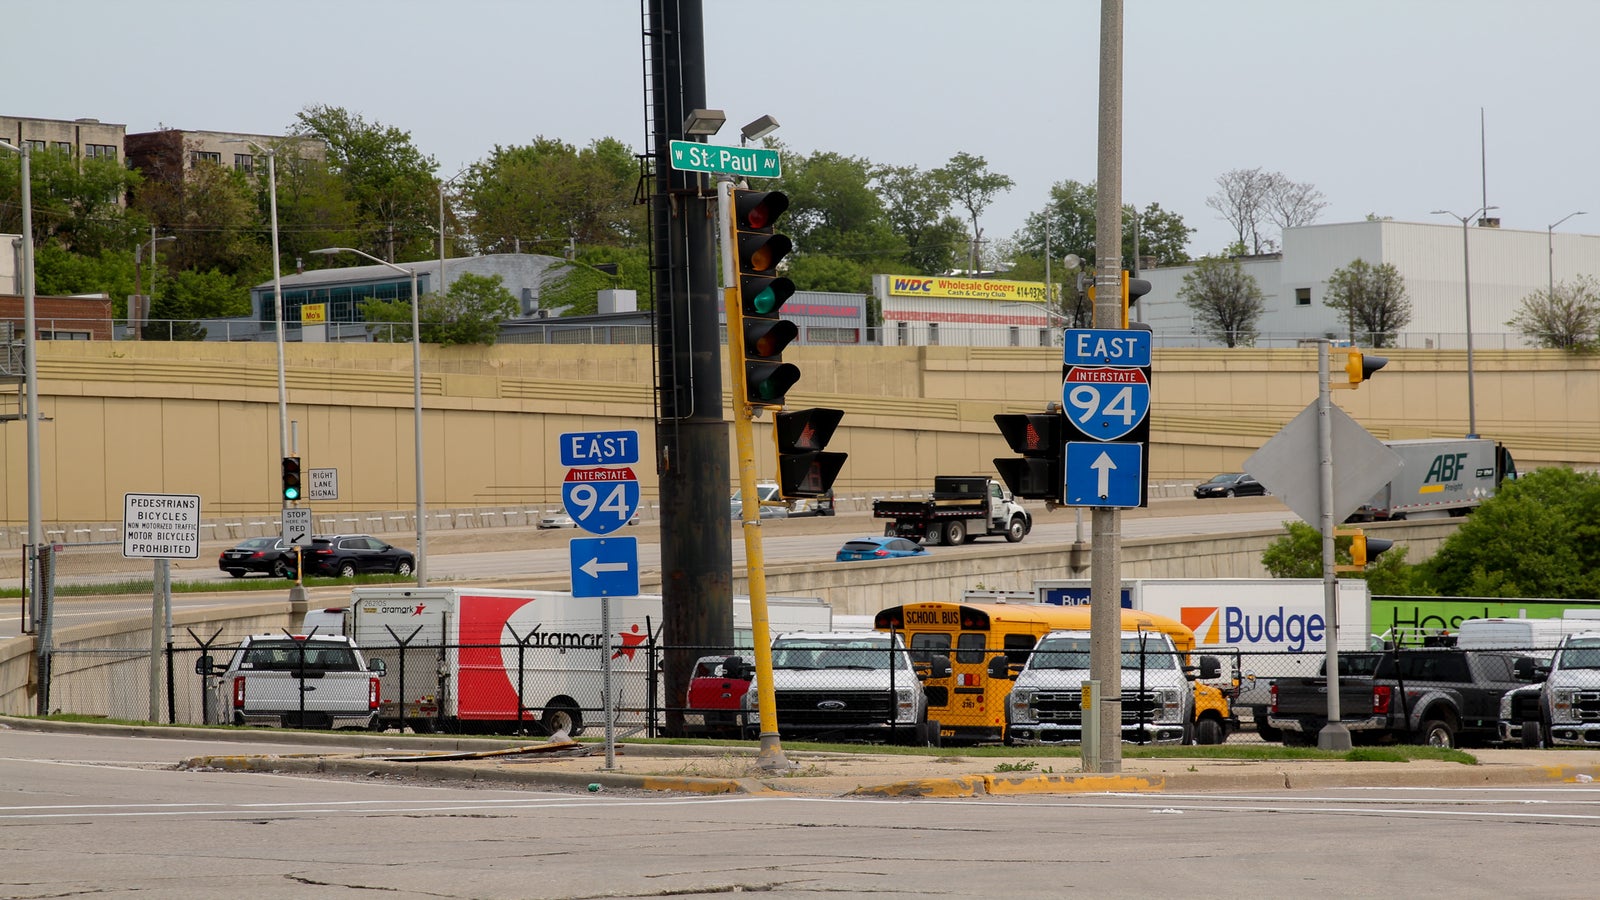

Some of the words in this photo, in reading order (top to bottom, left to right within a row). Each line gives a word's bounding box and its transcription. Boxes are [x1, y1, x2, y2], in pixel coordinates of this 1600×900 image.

[675, 150, 683, 160] W
[690, 147, 715, 168] St.
[720, 150, 757, 172] Paul
[764, 158, 776, 169] AV
[895, 278, 933, 292] WDC
[938, 280, 981, 291] Wholesale
[984, 282, 1015, 292] Grocers
[1077, 333, 1138, 358] EAST
[1076, 371, 1136, 382] INTERSTATE
[1069, 385, 1136, 425] 94
[572, 436, 628, 458] EAST
[1424, 453, 1468, 483] ABF
[573, 470, 628, 480] INTERSTATE
[131, 499, 195, 509] PEDESTRIANS
[570, 483, 630, 521] 94
[138, 511, 188, 521] BICYCLES
[128, 531, 153, 540] MOTOR
[157, 532, 195, 541] BICYCLES
[132, 544, 191, 554] PROHIBITED
[1062, 595, 1092, 606] Bud
[382, 605, 414, 614] aramark
[906, 611, 939, 624] SCHOOL
[942, 611, 959, 624] BUS
[1225, 606, 1325, 652] Budge
[527, 631, 614, 647] aramar
